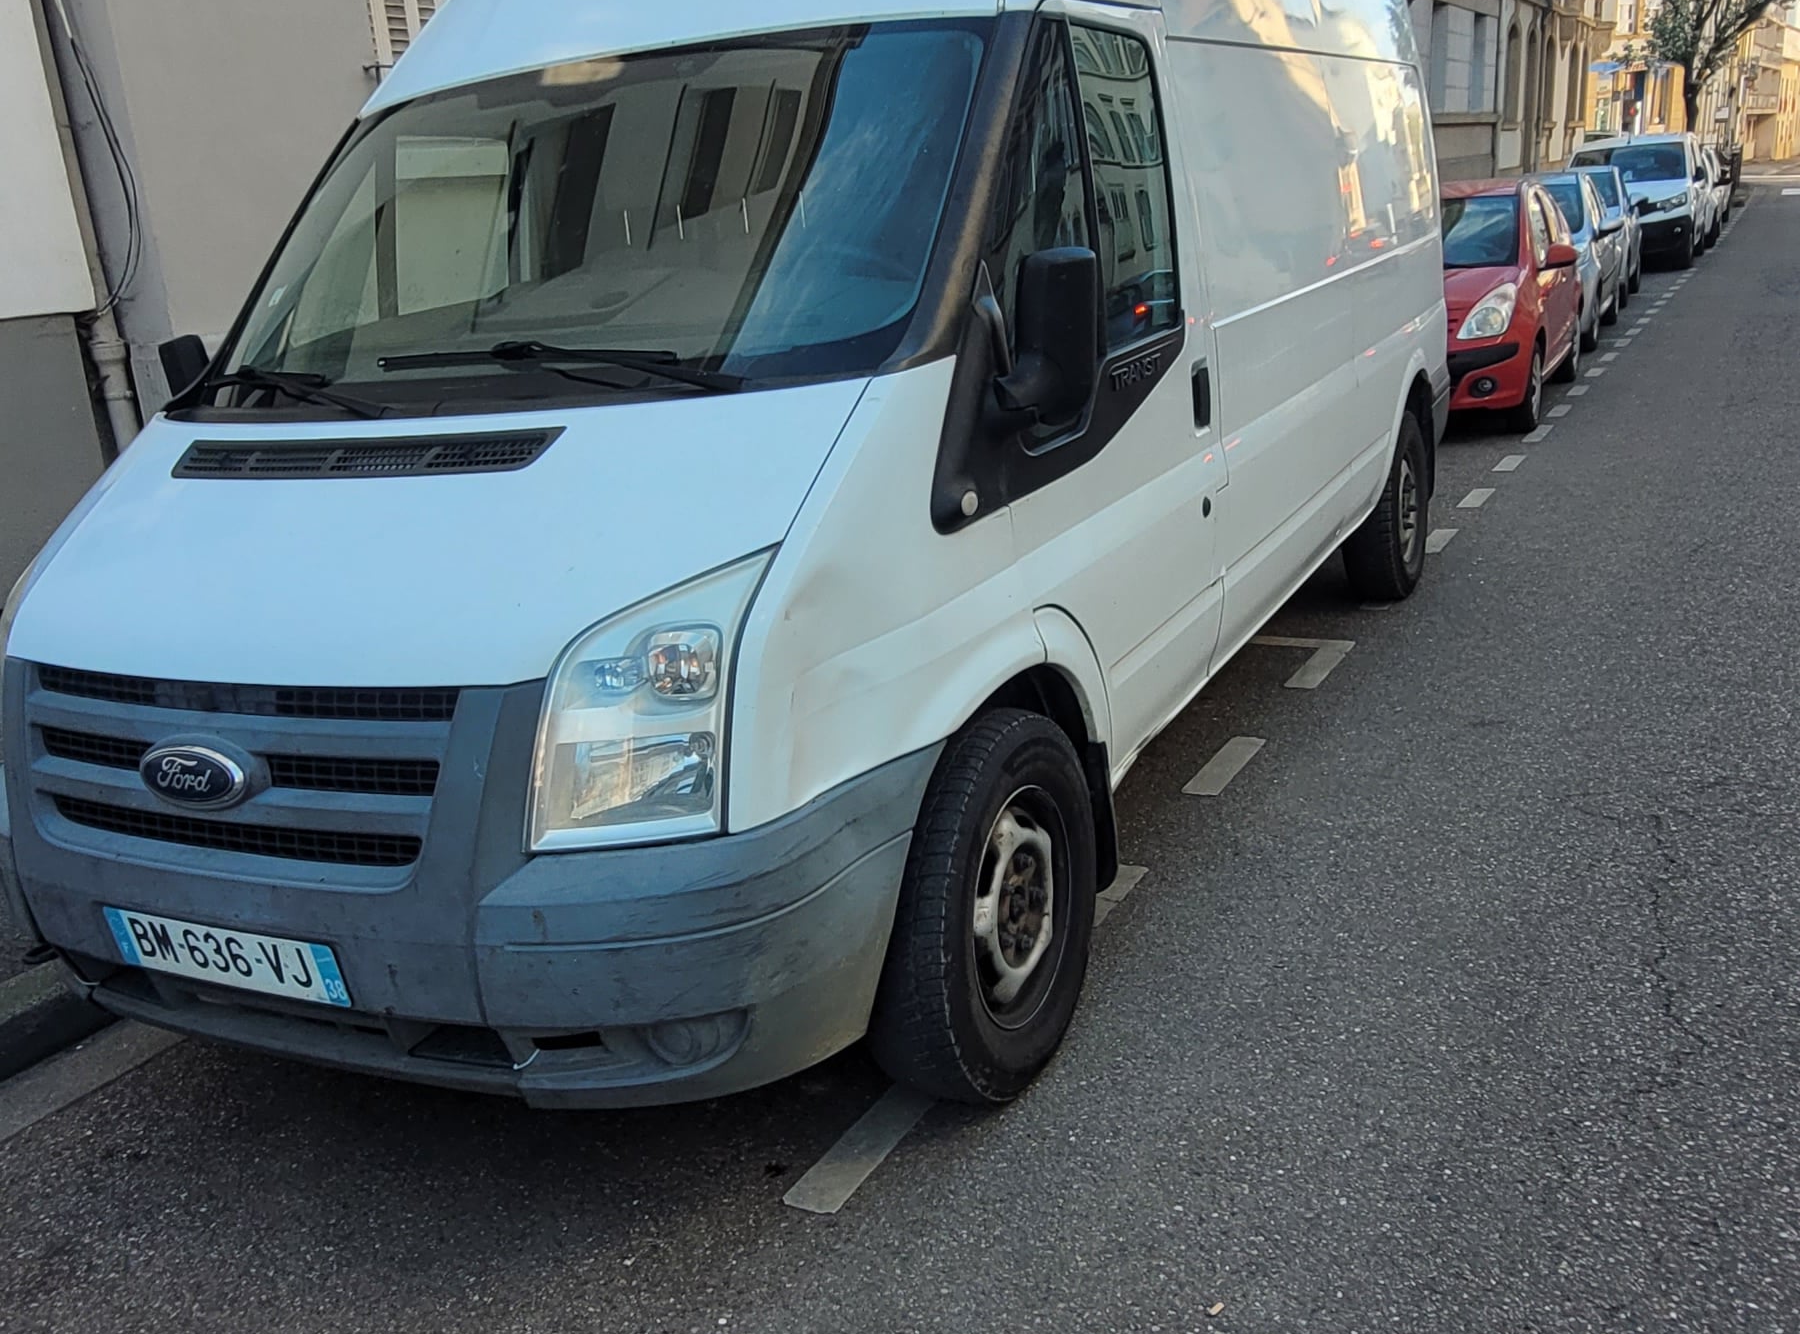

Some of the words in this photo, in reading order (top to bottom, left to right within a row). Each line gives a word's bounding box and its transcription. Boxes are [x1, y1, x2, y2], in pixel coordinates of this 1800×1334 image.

[157, 756, 211, 792] Ford
[127, 917, 313, 988] BM-636-VJ
[325, 978, 347, 1000] 38
